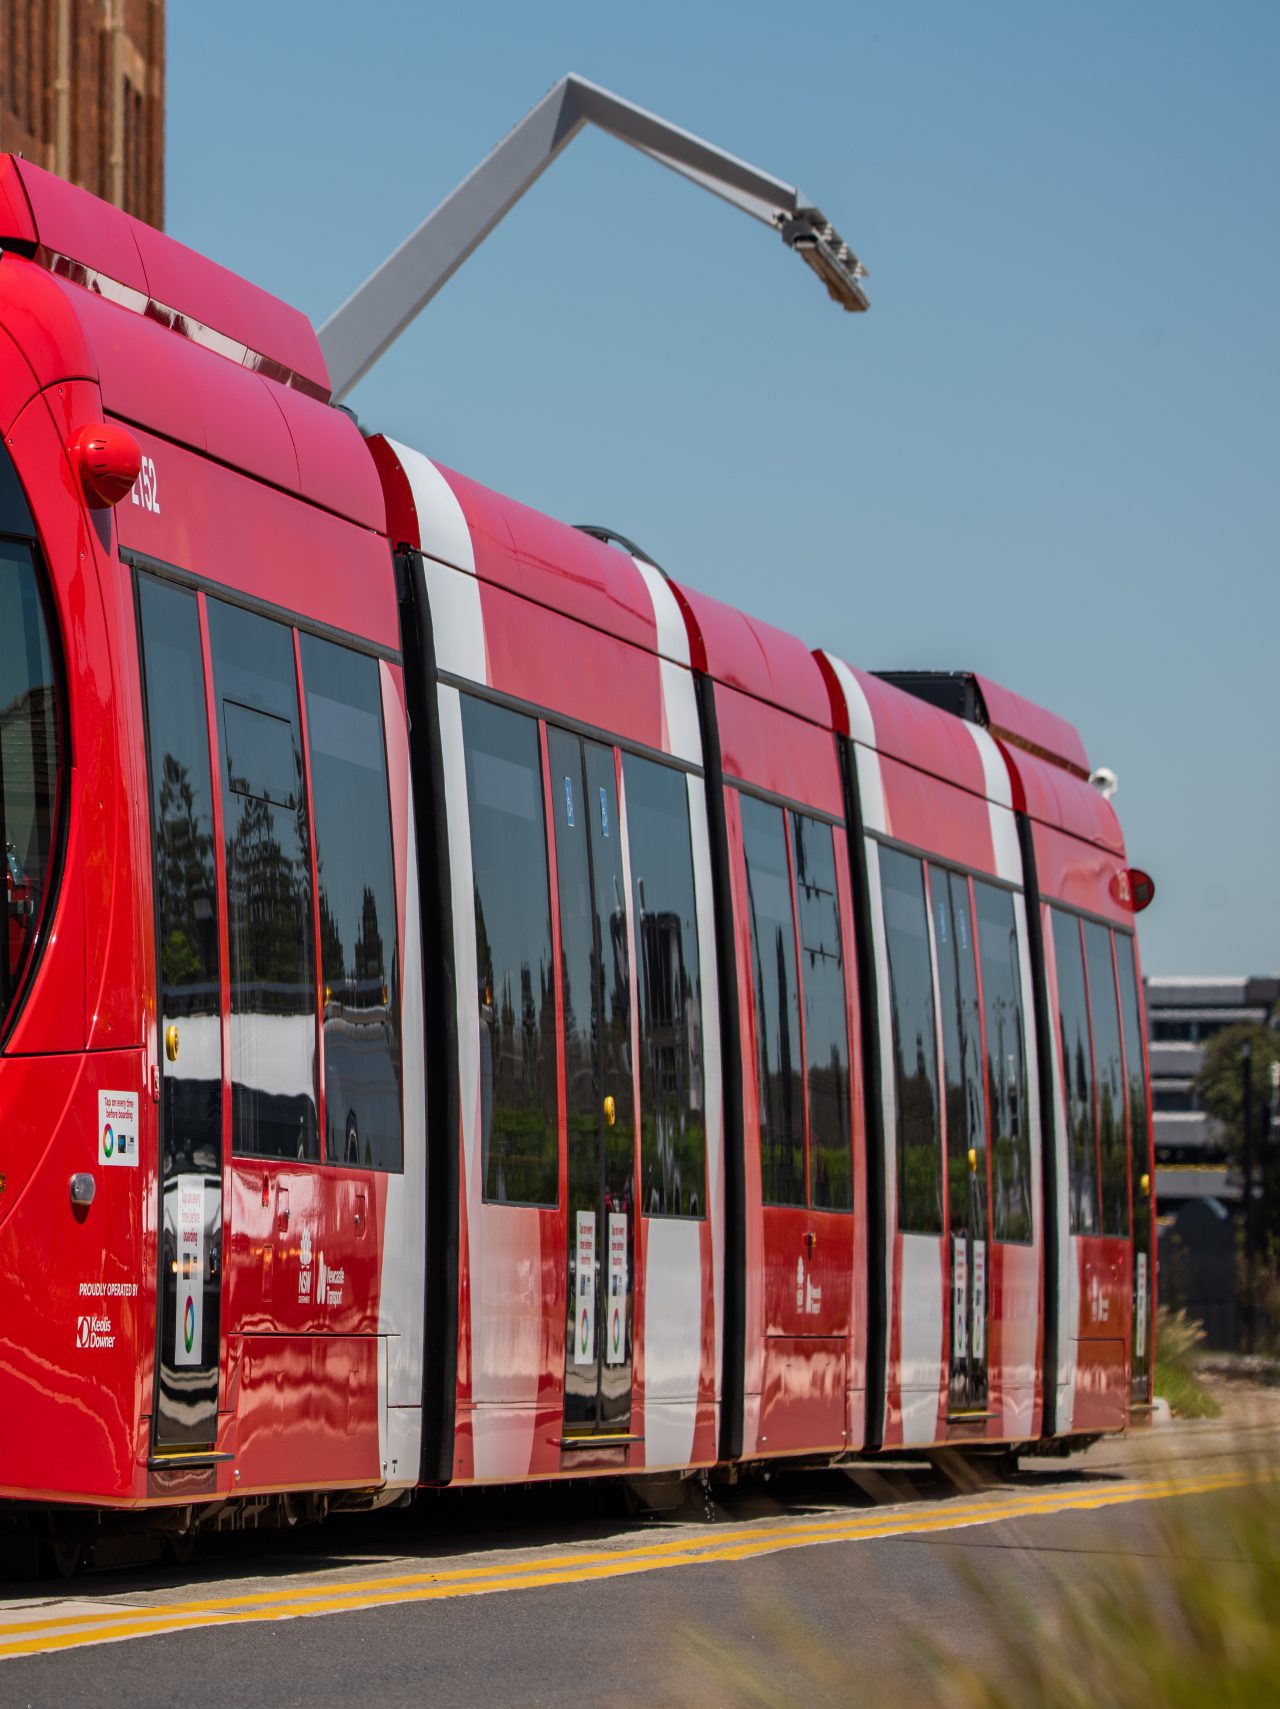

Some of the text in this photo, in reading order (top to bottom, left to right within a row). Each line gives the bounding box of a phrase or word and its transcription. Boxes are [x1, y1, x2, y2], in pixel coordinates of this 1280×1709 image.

[131, 456, 160, 514] 152
[79, 1283, 139, 1297] PROUDLY OPERATED BY
[91, 1315, 112, 1332] Keolis
[90, 1332, 116, 1348] Downer
